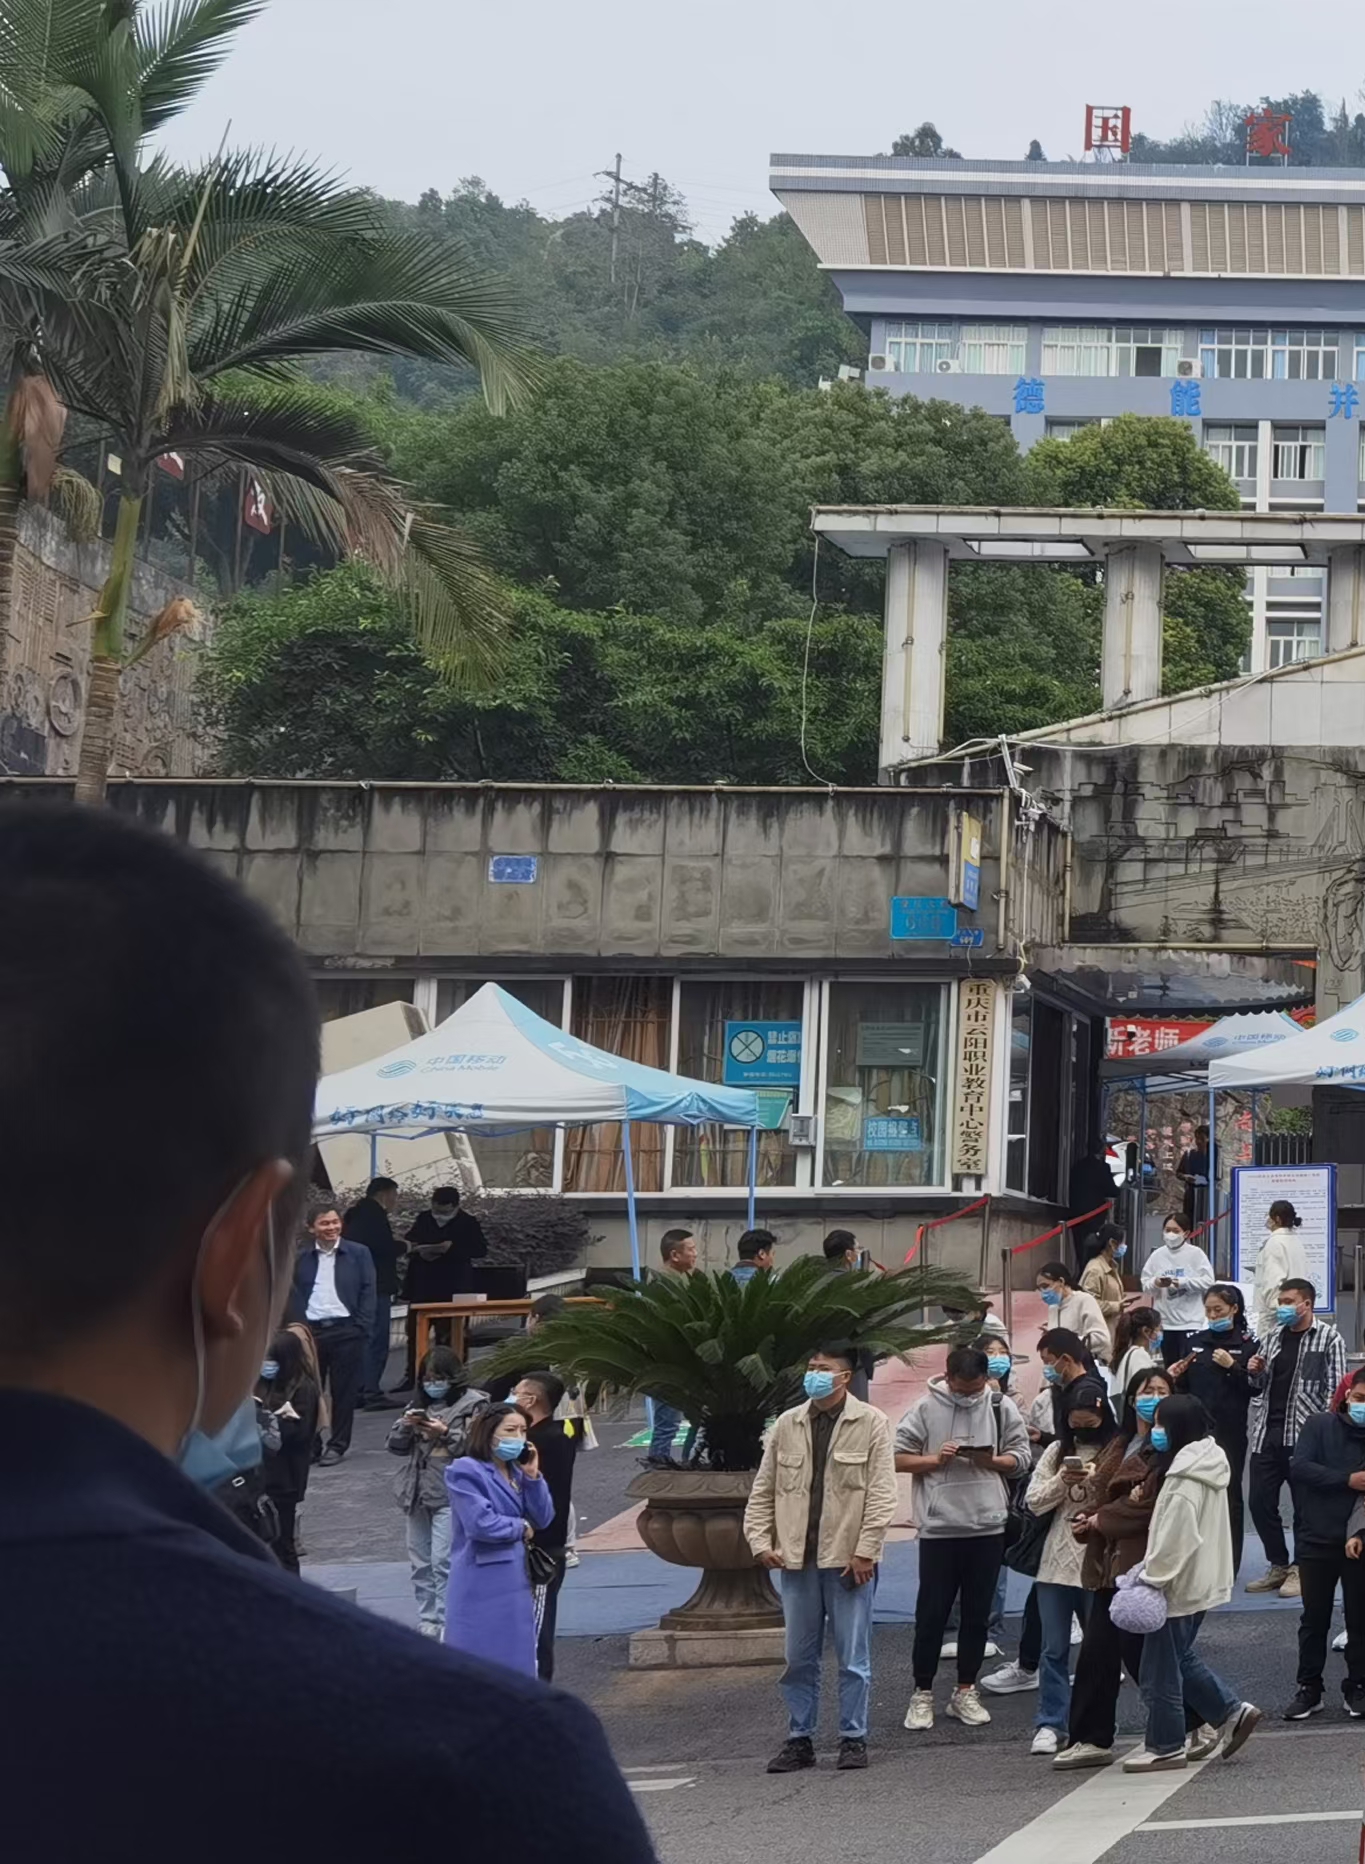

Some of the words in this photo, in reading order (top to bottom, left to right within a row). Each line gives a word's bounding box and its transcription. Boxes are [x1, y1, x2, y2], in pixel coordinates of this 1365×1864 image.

[957, 984, 992, 1171] 重庆市云阳职业教育中心警务室
